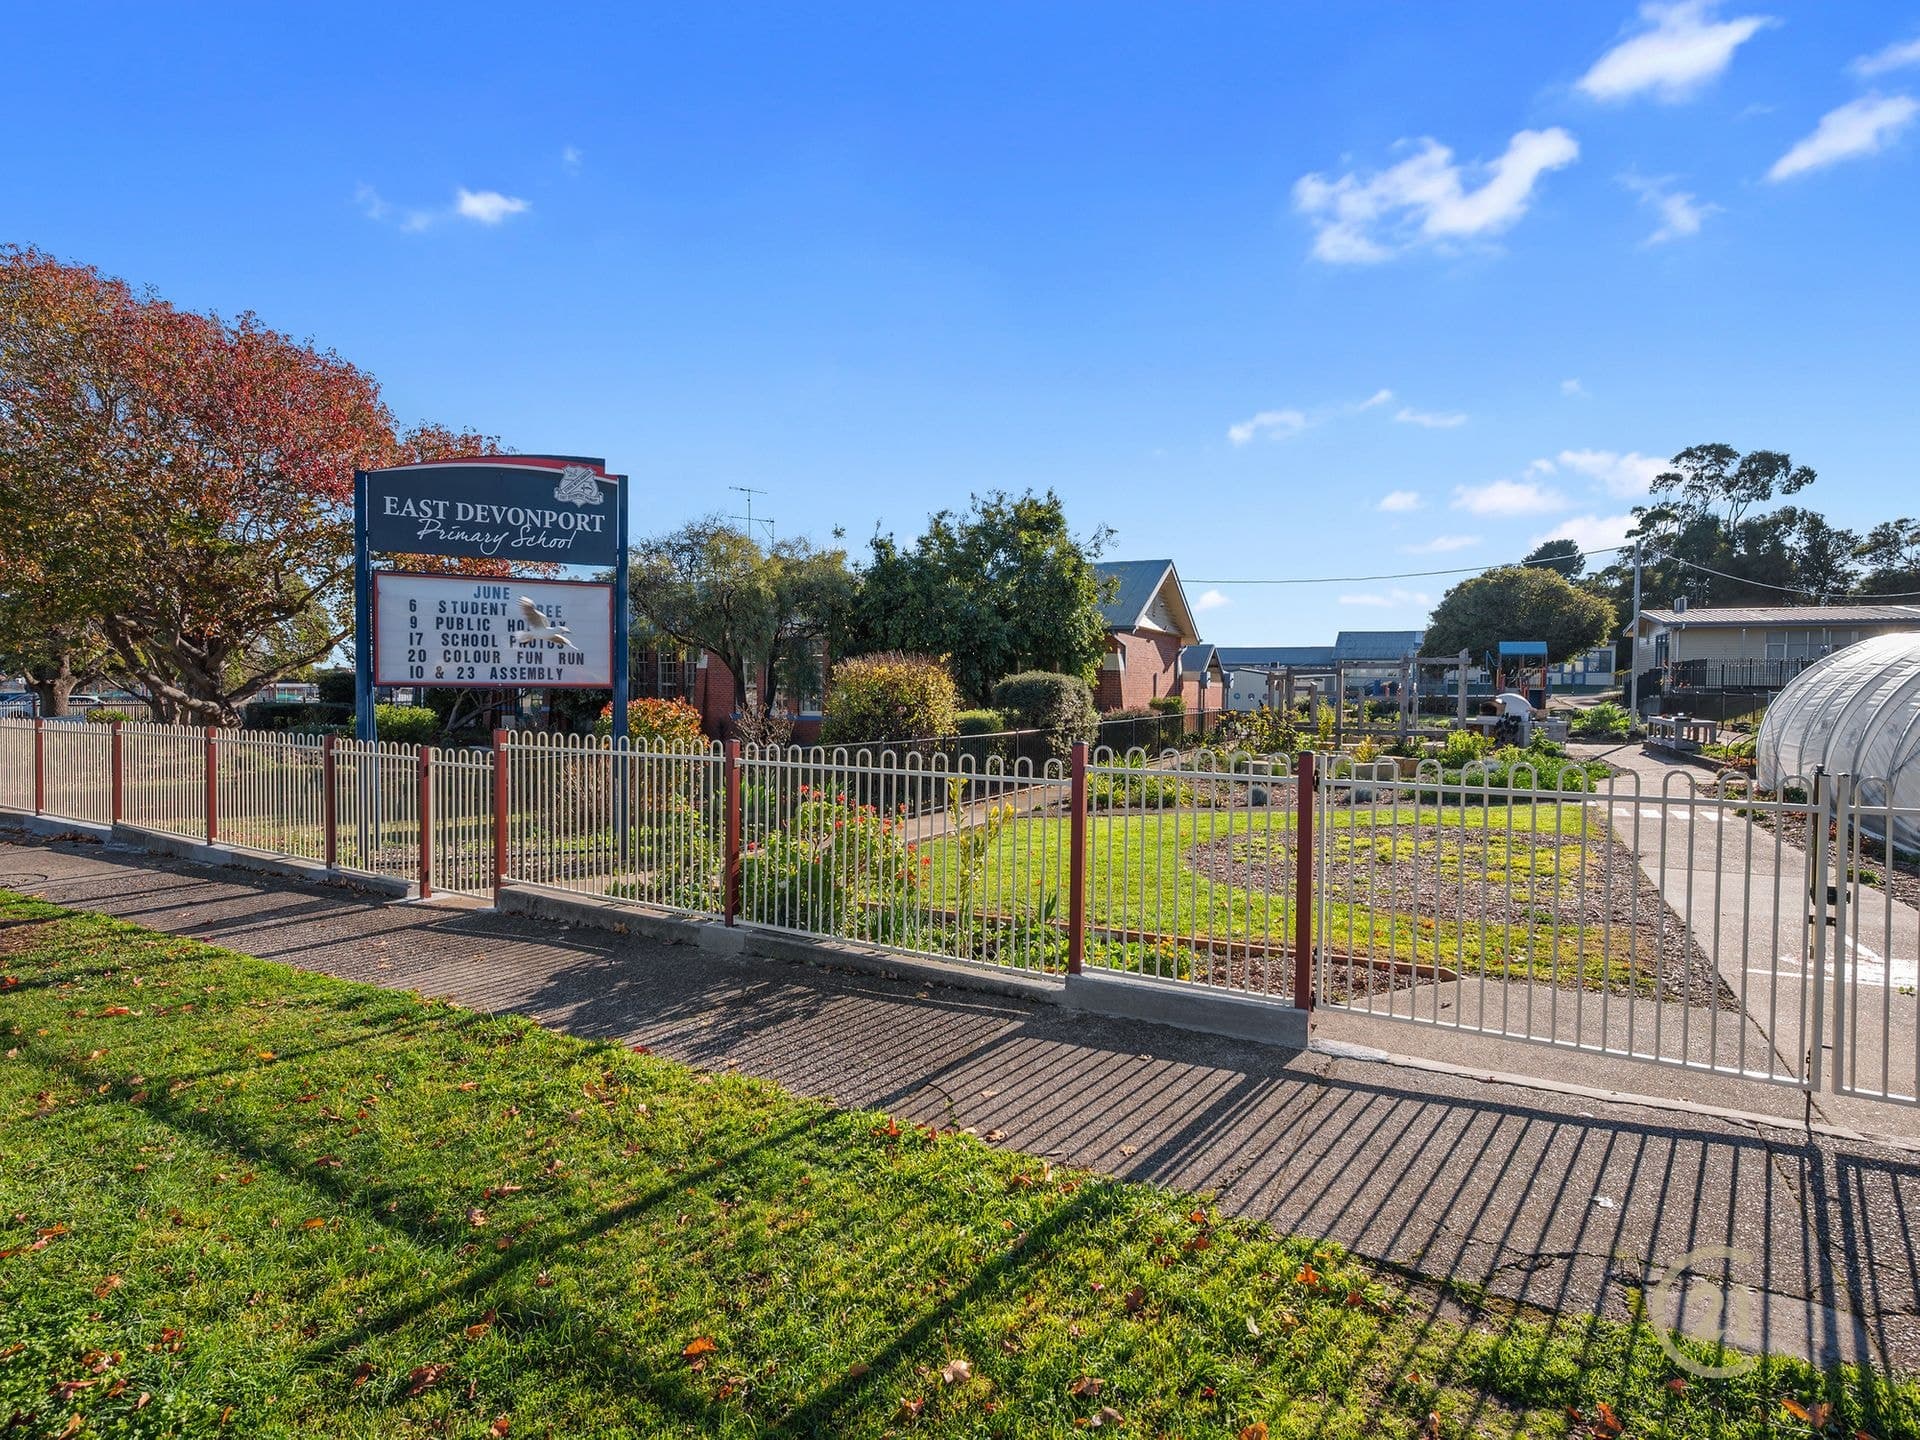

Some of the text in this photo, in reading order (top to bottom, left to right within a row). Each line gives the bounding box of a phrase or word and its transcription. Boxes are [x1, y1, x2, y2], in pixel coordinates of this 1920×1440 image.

[383, 496, 605, 532] EAST DEVONPORT
[417, 518, 576, 555] Primary School
[473, 586, 510, 599] JUNE
[409, 599, 562, 618] 6 STUDENT REE
[410, 616, 418, 628] 9
[436, 617, 490, 632] PUBLIC
[409, 633, 423, 645] 17
[441, 633, 498, 648] SCHOOL
[408, 649, 584, 665] 20 COLOUR FUN RUN
[410, 666, 563, 680] 10 & 23 ASSEMBLY
